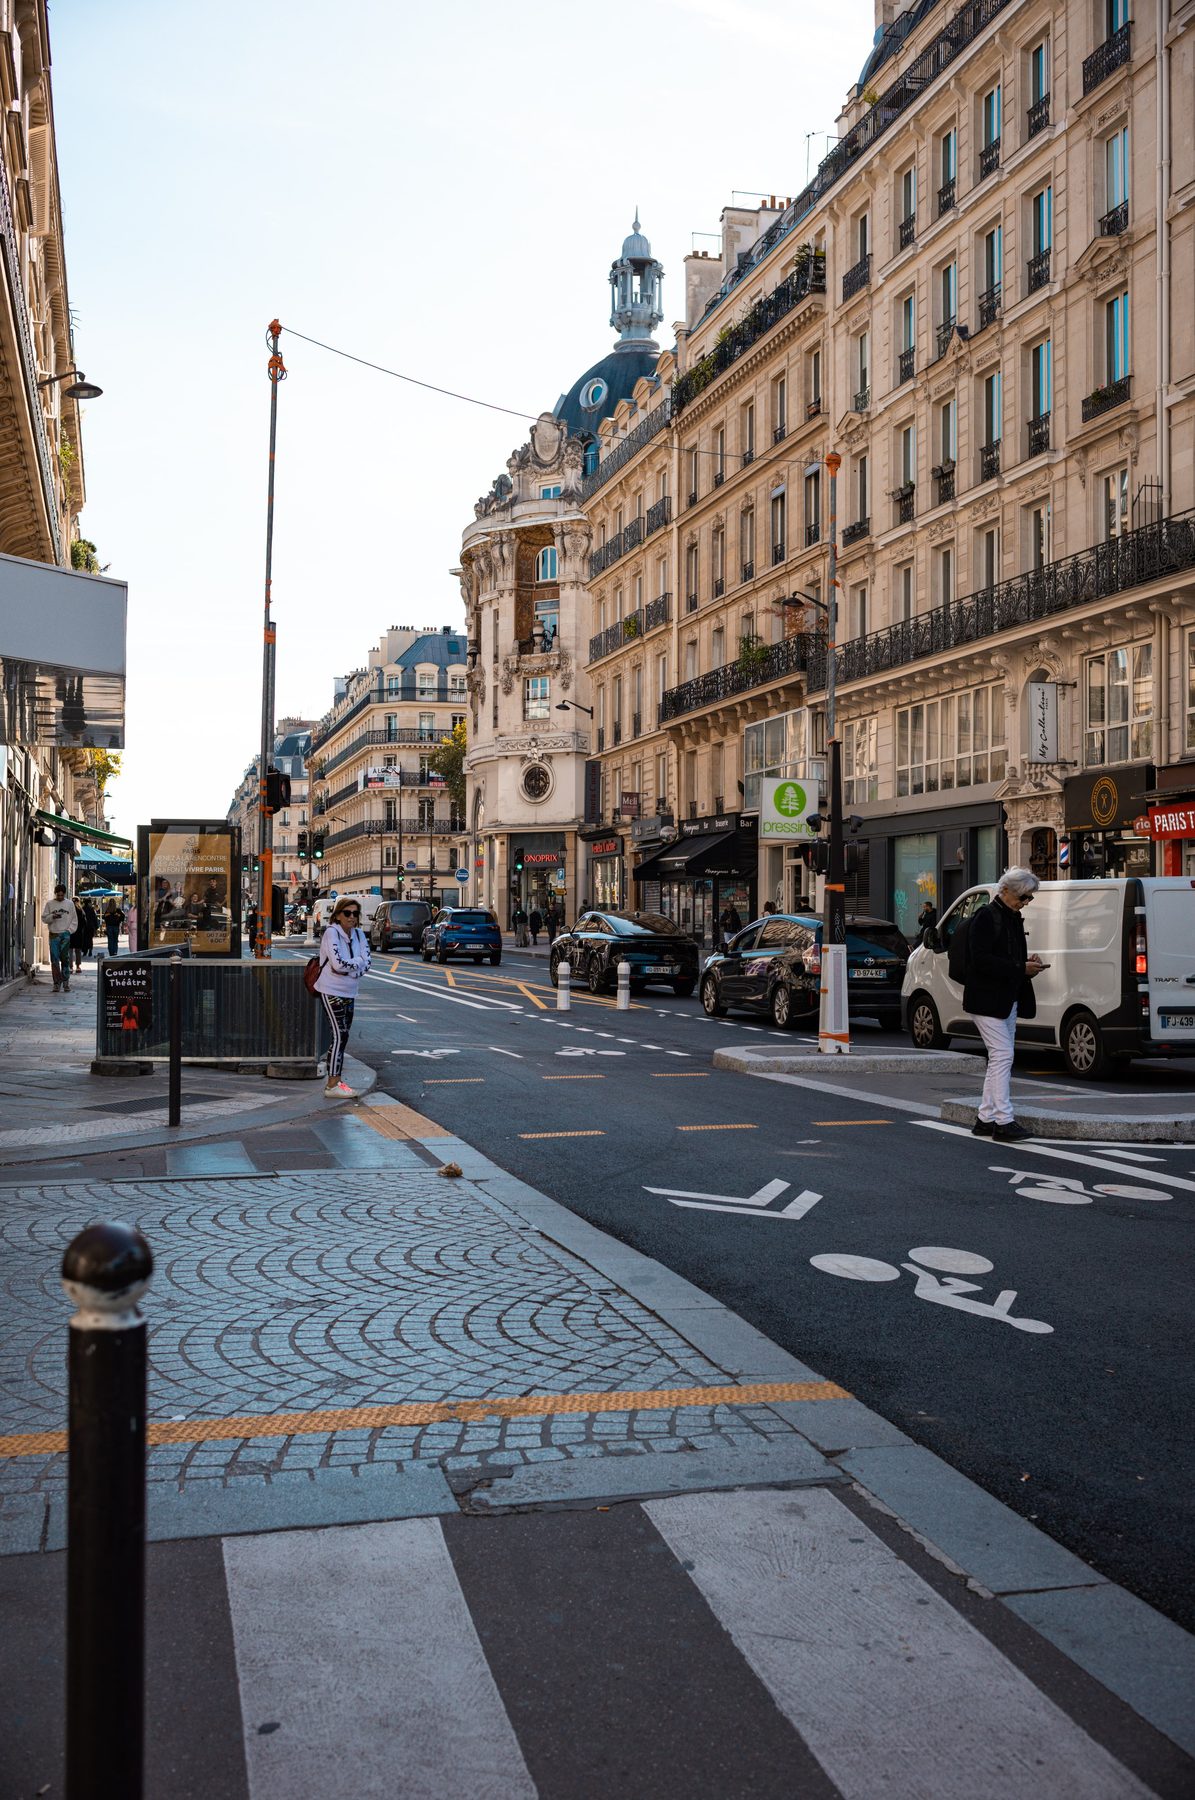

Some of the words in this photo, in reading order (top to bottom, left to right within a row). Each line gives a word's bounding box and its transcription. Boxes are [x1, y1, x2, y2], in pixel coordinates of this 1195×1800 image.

[1038, 742, 1048, 758] My
[740, 819, 753, 828] Bar
[1135, 818, 1151, 830] ria
[1154, 811, 1187, 832] PARIS
[763, 820, 816, 837] pressing
[523, 854, 558, 863] ONOPRIX
[105, 968, 133, 977] Cours
[136, 967, 147, 976] de
[109, 978, 147, 987] Théâtre
